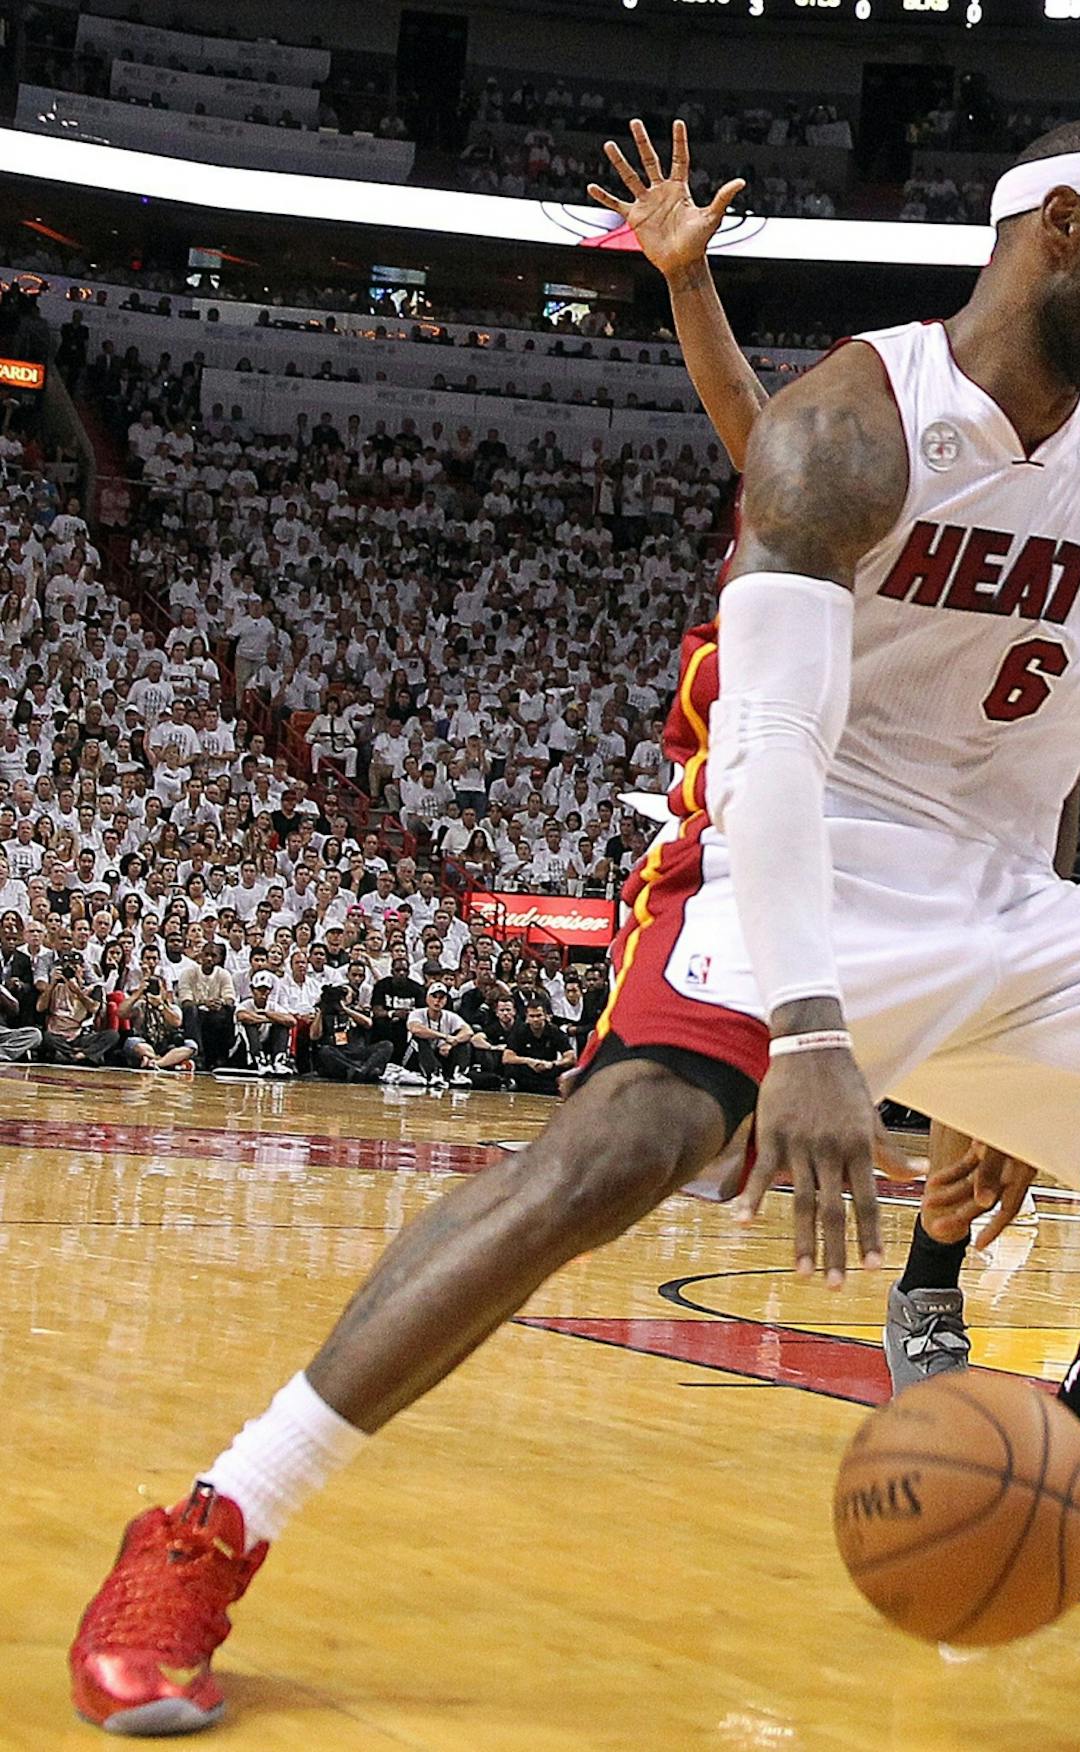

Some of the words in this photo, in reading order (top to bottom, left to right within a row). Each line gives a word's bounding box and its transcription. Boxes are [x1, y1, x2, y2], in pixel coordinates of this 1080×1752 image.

[0, 364, 38, 383] ARDI
[982, 637, 1069, 724] 6
[470, 901, 609, 931] Budweiser
